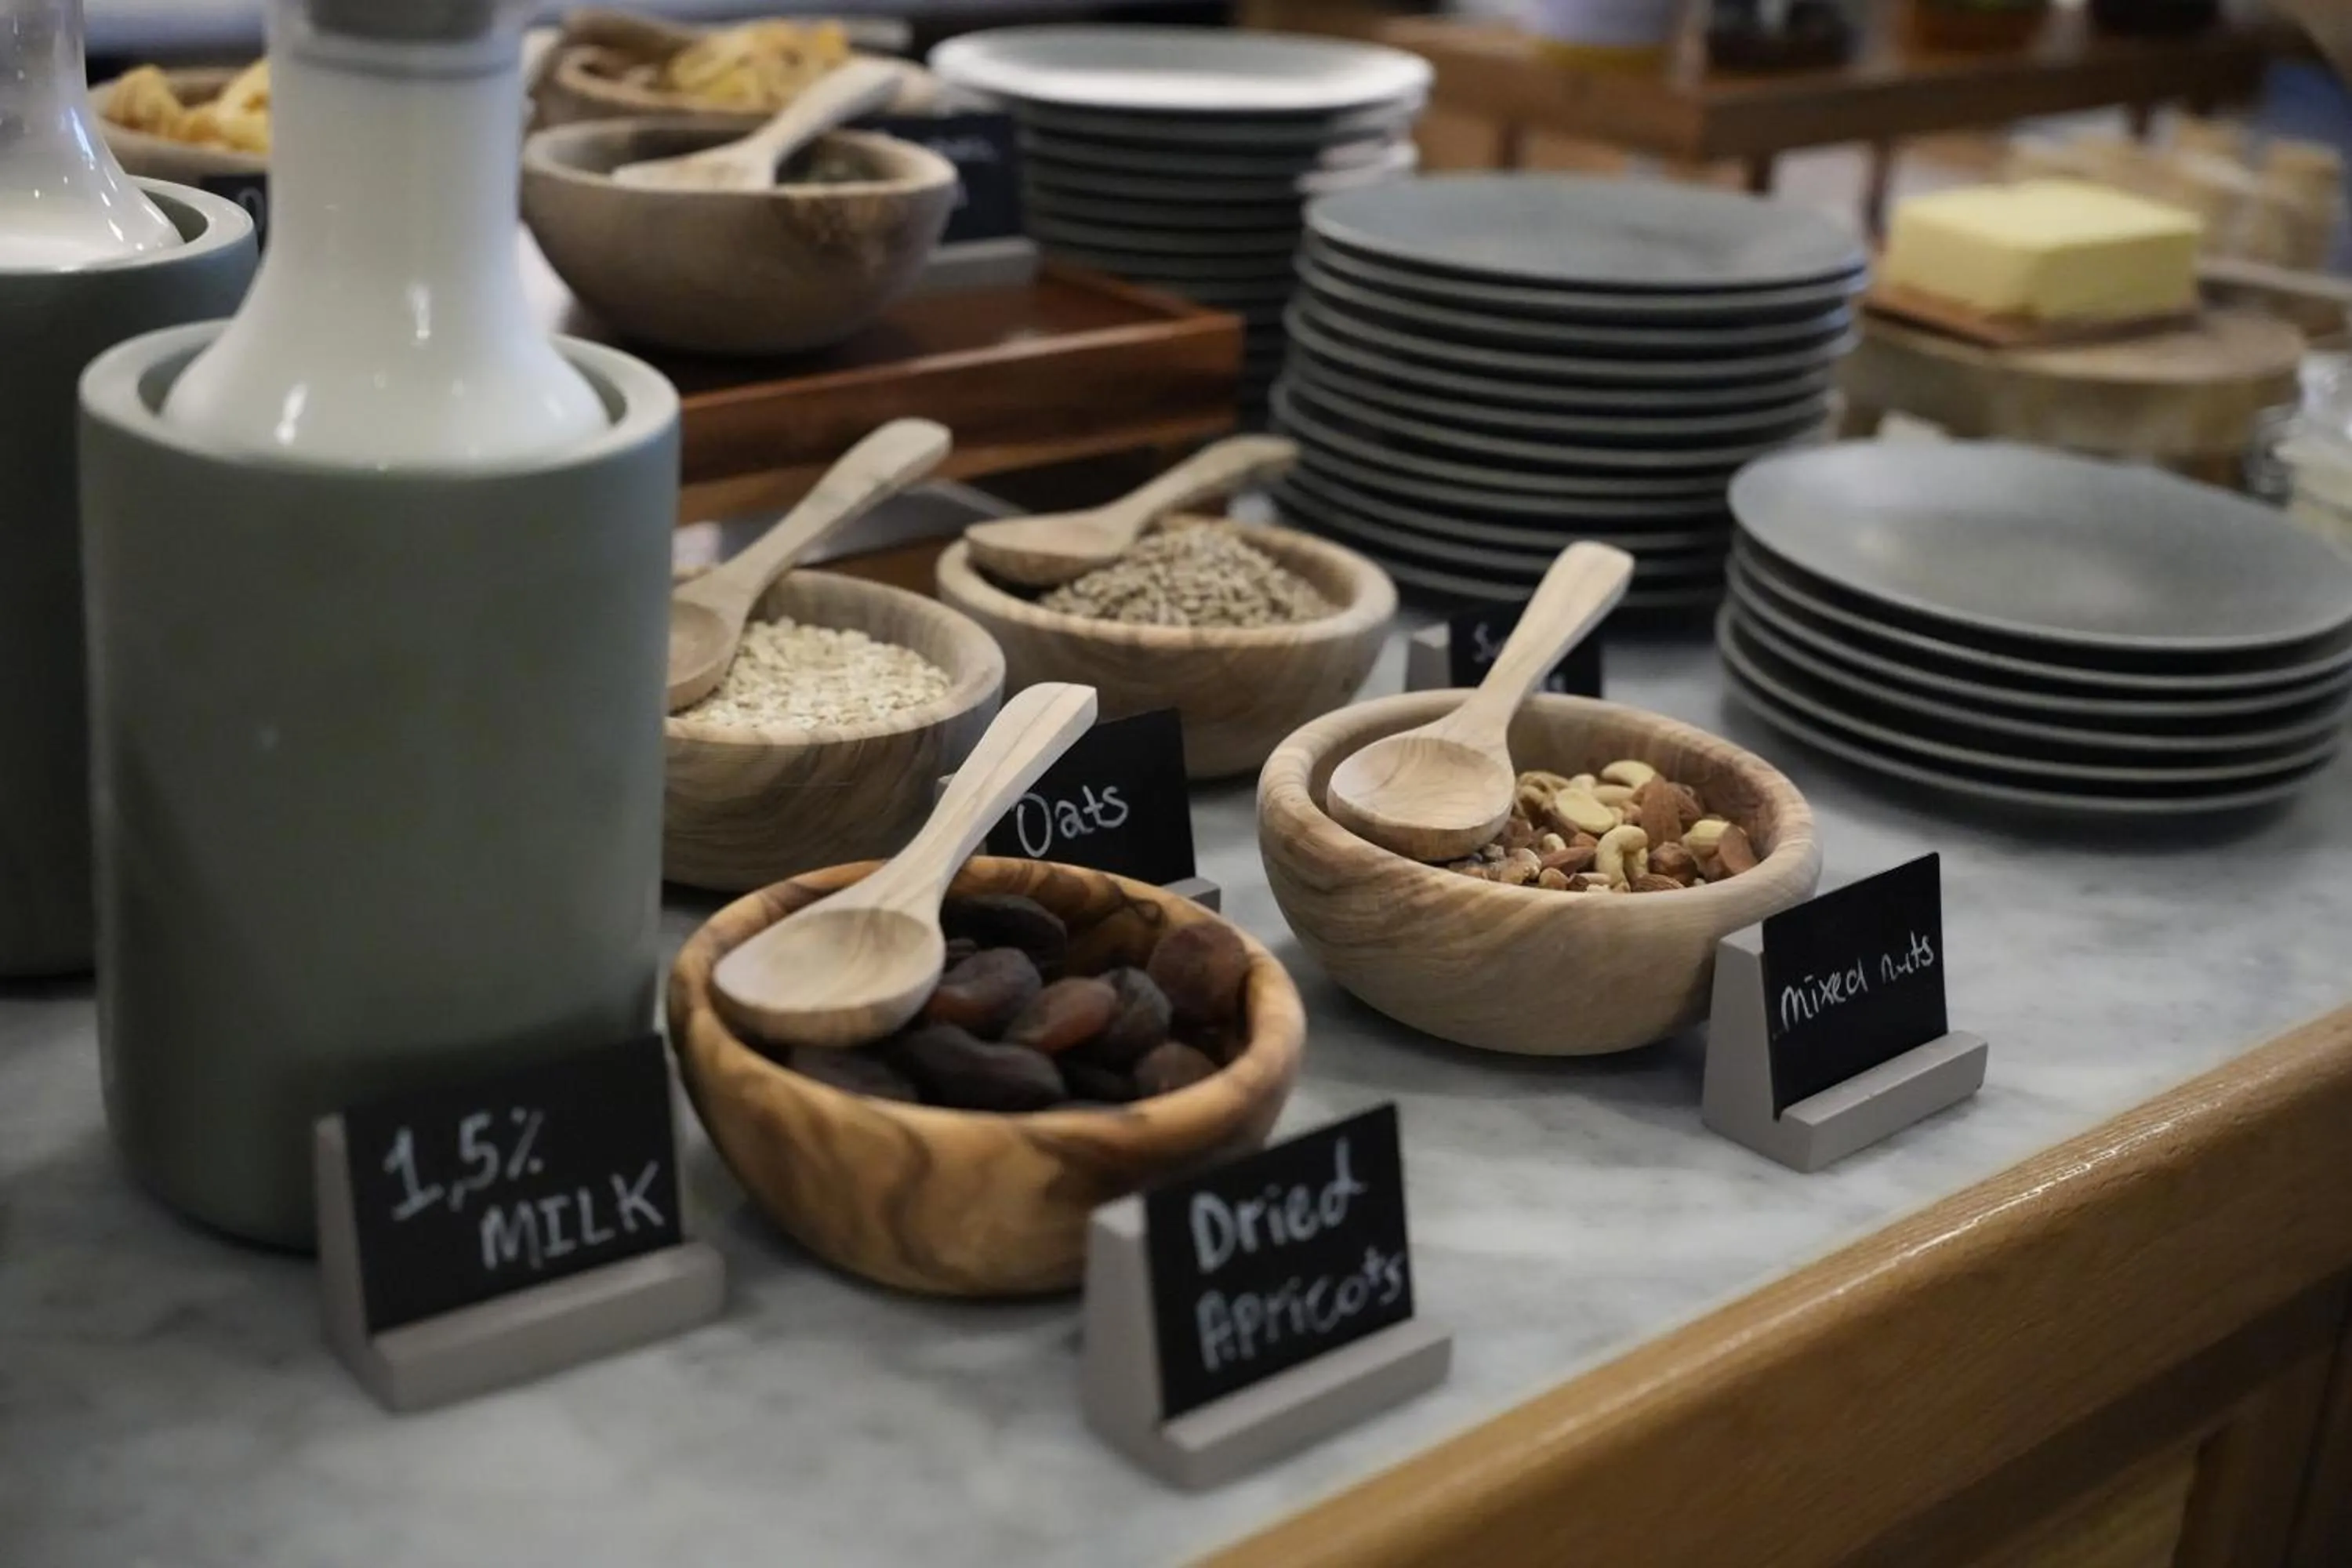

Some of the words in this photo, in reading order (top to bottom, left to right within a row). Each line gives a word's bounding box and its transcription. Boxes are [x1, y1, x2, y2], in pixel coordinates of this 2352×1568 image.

[1015, 783, 1130, 858] Oats
[383, 1105, 544, 1221] 1,5%
[480, 1160, 665, 1271] MILK
[1189, 1136, 1368, 1275] Dried
